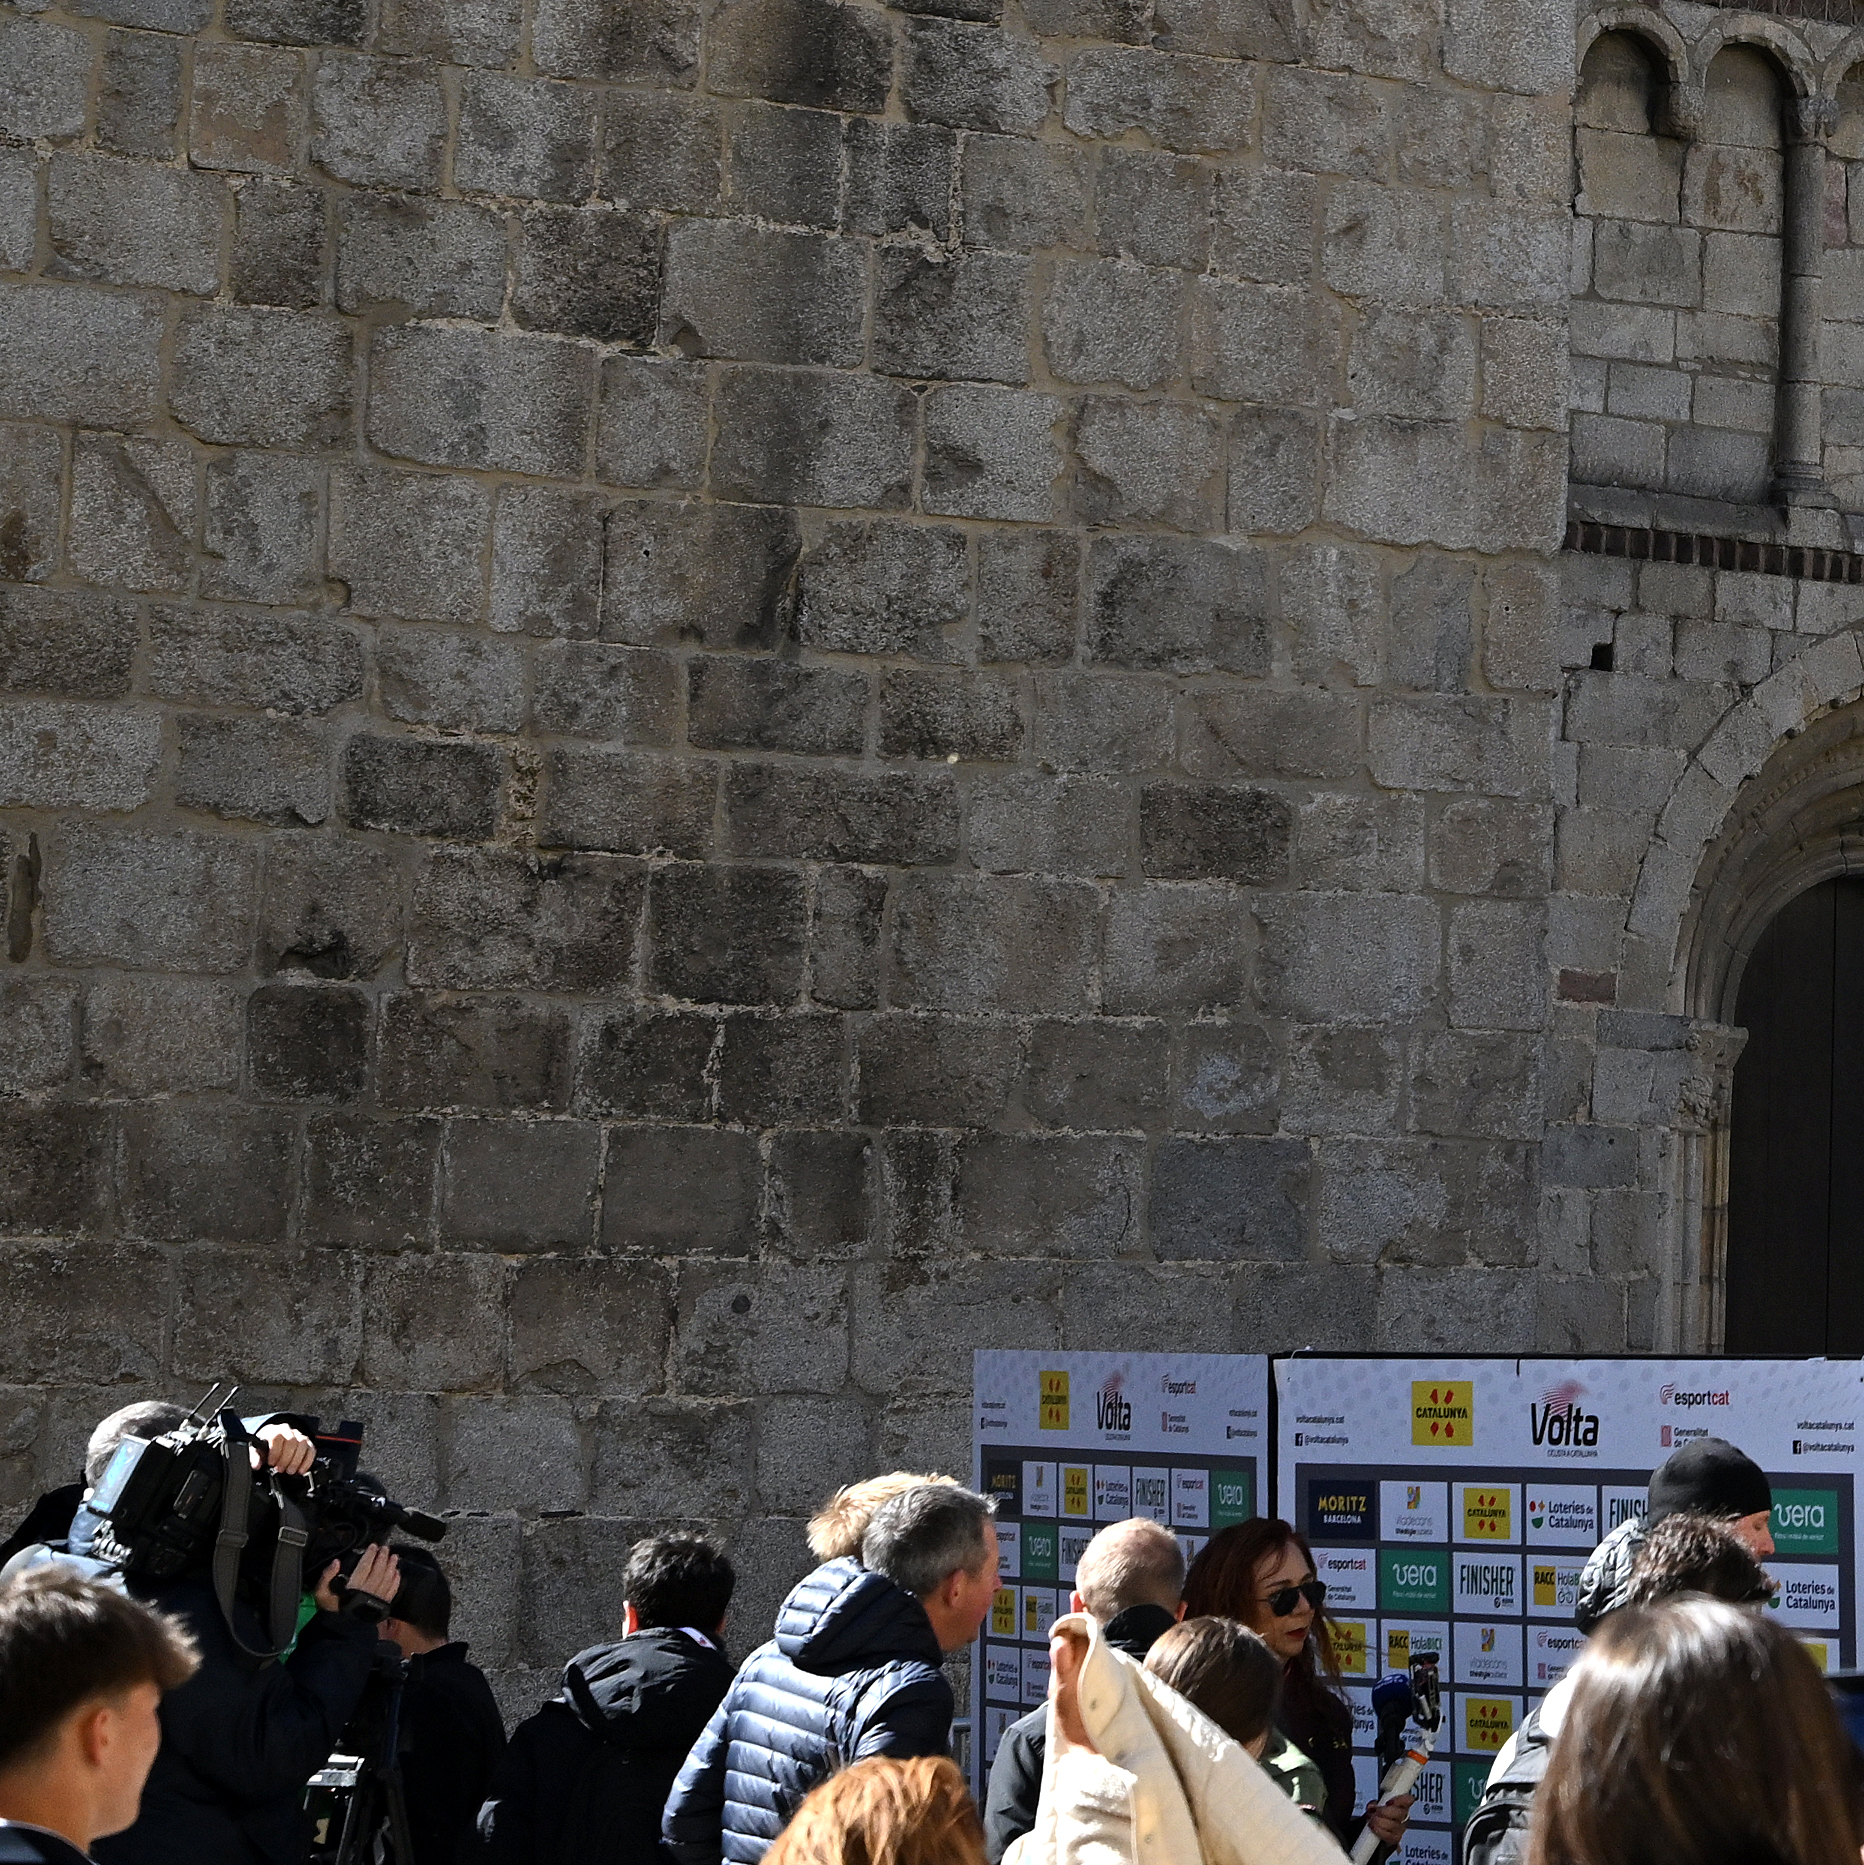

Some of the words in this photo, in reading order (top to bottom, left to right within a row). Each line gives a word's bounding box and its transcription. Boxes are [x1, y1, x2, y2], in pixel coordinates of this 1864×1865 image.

[1674, 1390, 1730, 1409] esportcat
[1097, 1390, 1132, 1430] Volta
[1416, 1407, 1467, 1419] CATALUNYA
[1531, 1403, 1599, 1446] Volta
[1674, 1427, 1708, 1437] Generalitat
[1797, 1420, 1854, 1432] voltacatalunya.cat
[1218, 1484, 1243, 1505] vera
[1318, 1495, 1366, 1512] MORITZ
[1549, 1500, 1585, 1514] Loteries
[1586, 1506, 1593, 1514] de
[1323, 1514, 1363, 1524] BARCELONA
[1467, 1508, 1506, 1518] CATALUNYA
[1774, 1503, 1824, 1528] vera
[1549, 1515, 1594, 1533] Catalunya
[1328, 1558, 1366, 1572] esportcat
[1392, 1563, 1437, 1586] vera
[1460, 1565, 1514, 1596] FINISHER
[1534, 1572, 1555, 1585] RACC
[1786, 1580, 1826, 1595] Loteries
[1827, 1587, 1835, 1595] de
[1786, 1596, 1836, 1613] Catalunya
[1389, 1635, 1408, 1649] RACC
[1470, 1719, 1509, 1729] CATALUNYA
[1406, 1845, 1440, 1860] Loteries
